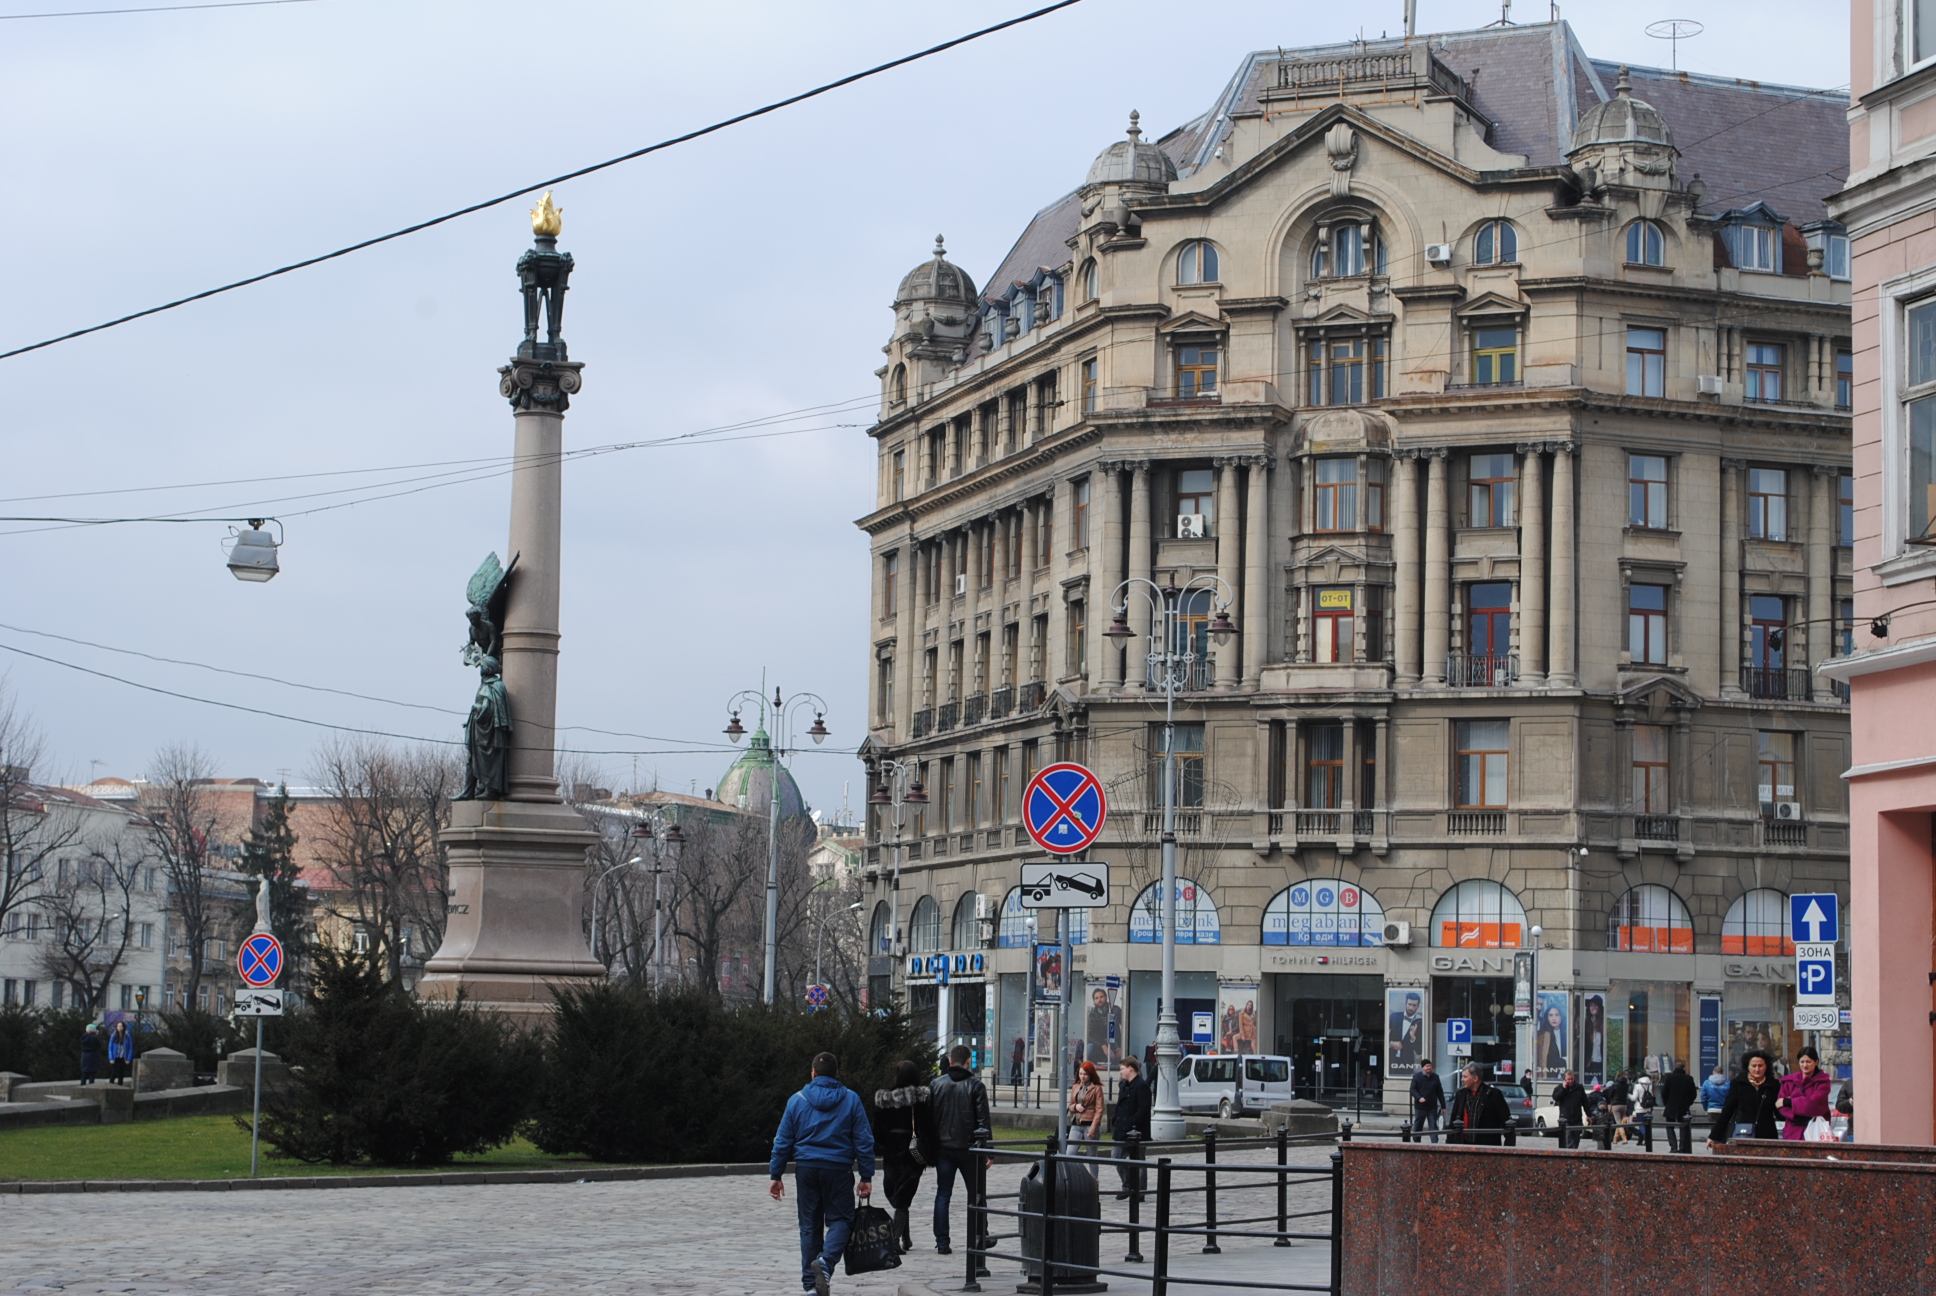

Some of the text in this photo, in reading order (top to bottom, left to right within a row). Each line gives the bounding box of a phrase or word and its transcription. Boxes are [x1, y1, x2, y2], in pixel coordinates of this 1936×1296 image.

[1272, 912, 1372, 933] megabank
[1298, 932, 1350, 943] Кредити
[1799, 947, 1831, 958] ЗОНА
[948, 953, 982, 972] MOYO
[1270, 956, 1378, 967] TOMMY HILFIGER
[1807, 964, 1825, 992] P
[1808, 1014, 1819, 1022] 25
[1821, 1013, 1834, 1023] 50
[1452, 1021, 1466, 1041] P
